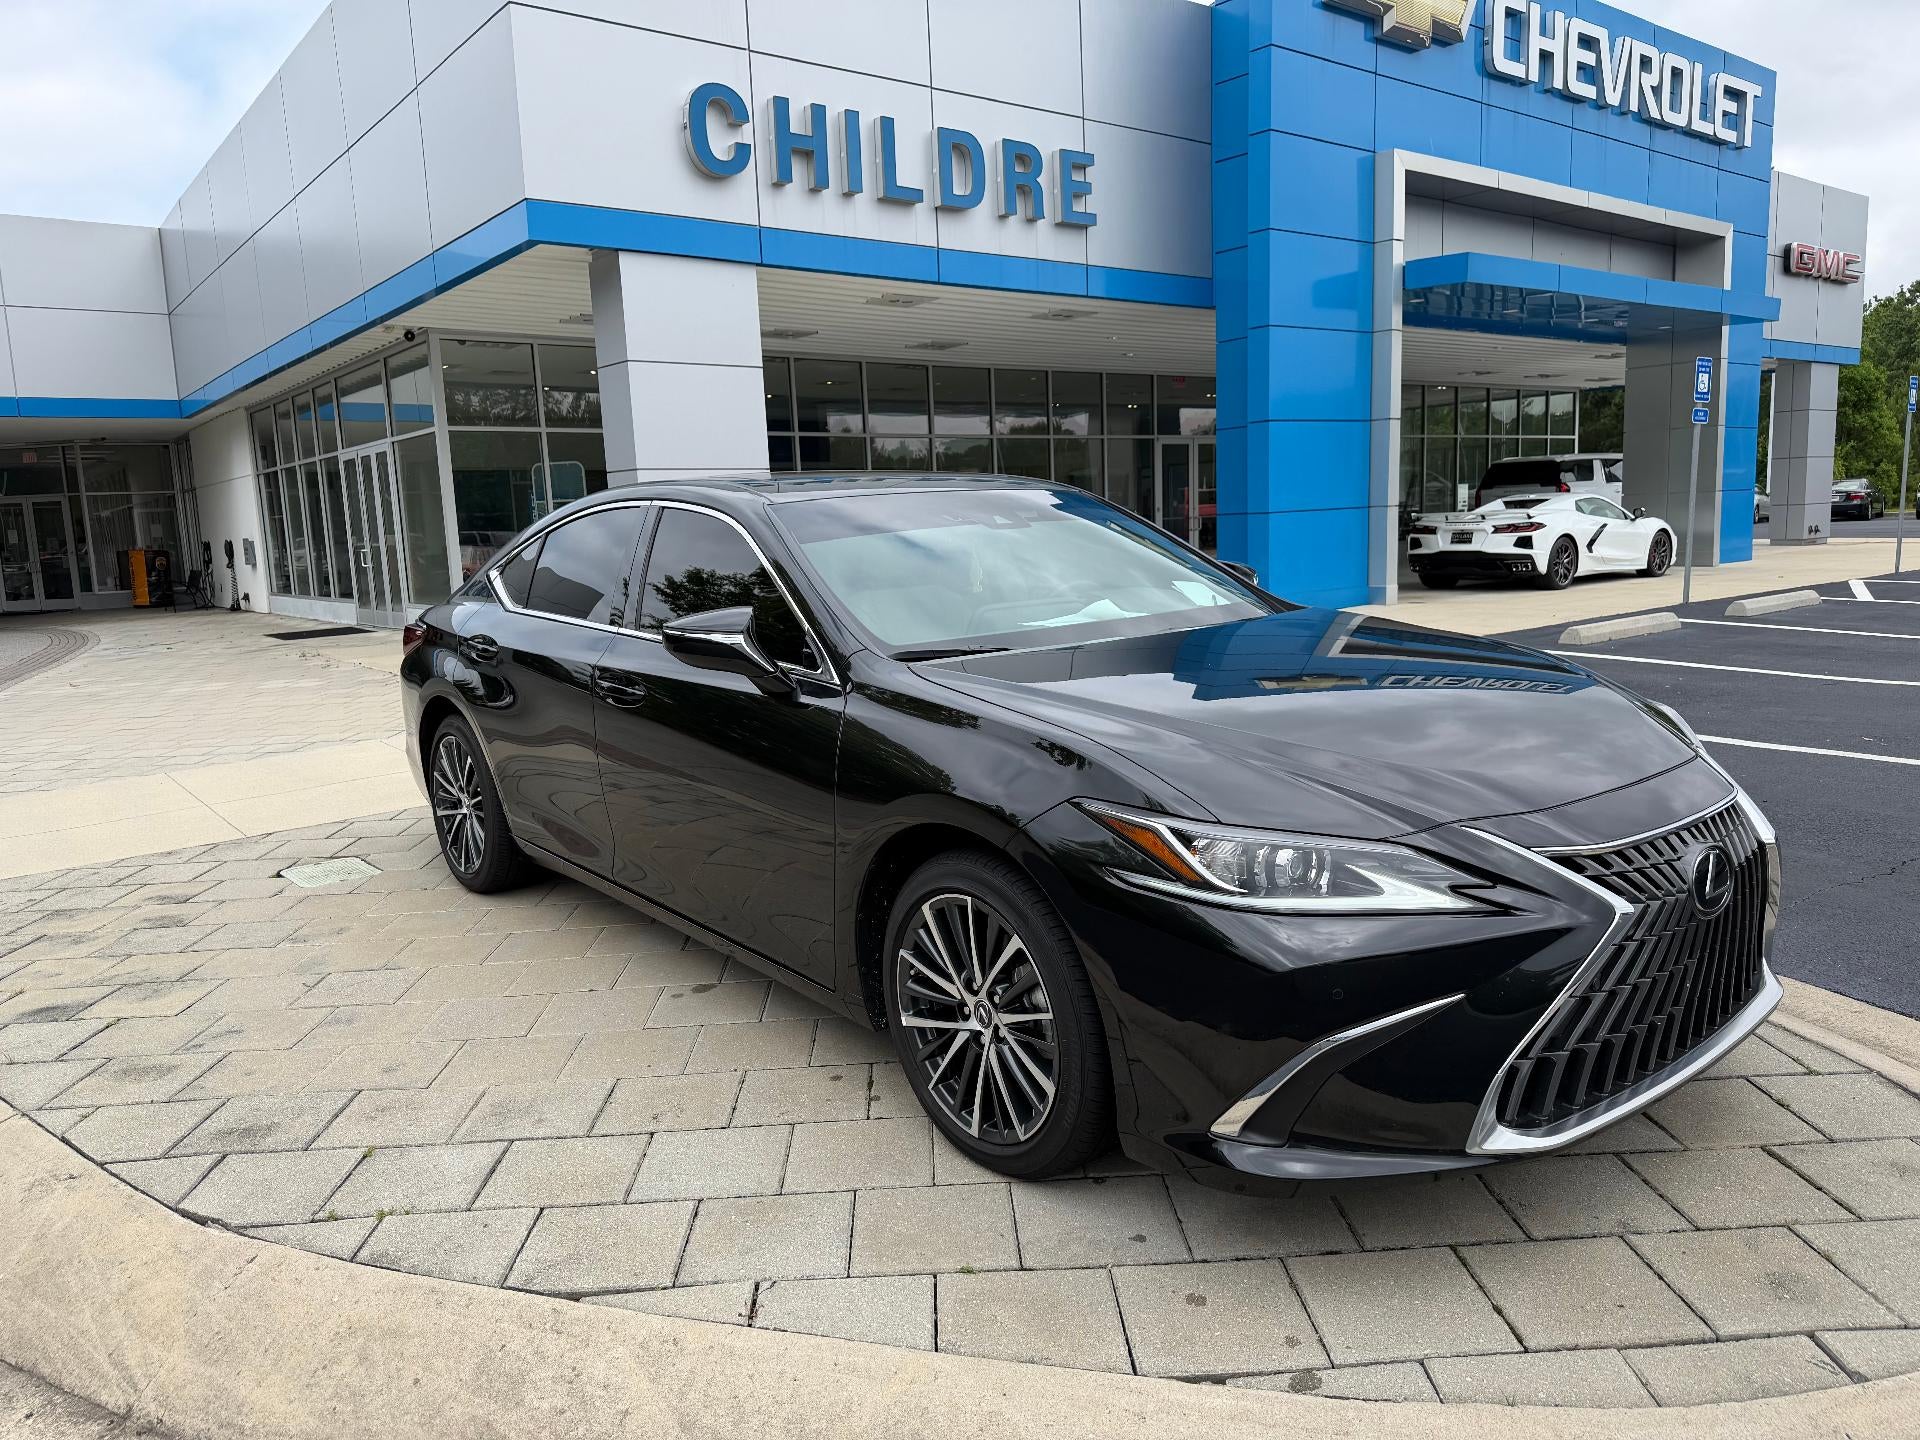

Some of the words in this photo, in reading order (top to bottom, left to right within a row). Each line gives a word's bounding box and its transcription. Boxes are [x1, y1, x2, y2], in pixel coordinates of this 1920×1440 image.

[1484, 0, 1762, 148] CHEVROLET
[685, 82, 1097, 227] CHILDRE
[1790, 242, 1861, 283] GMC
